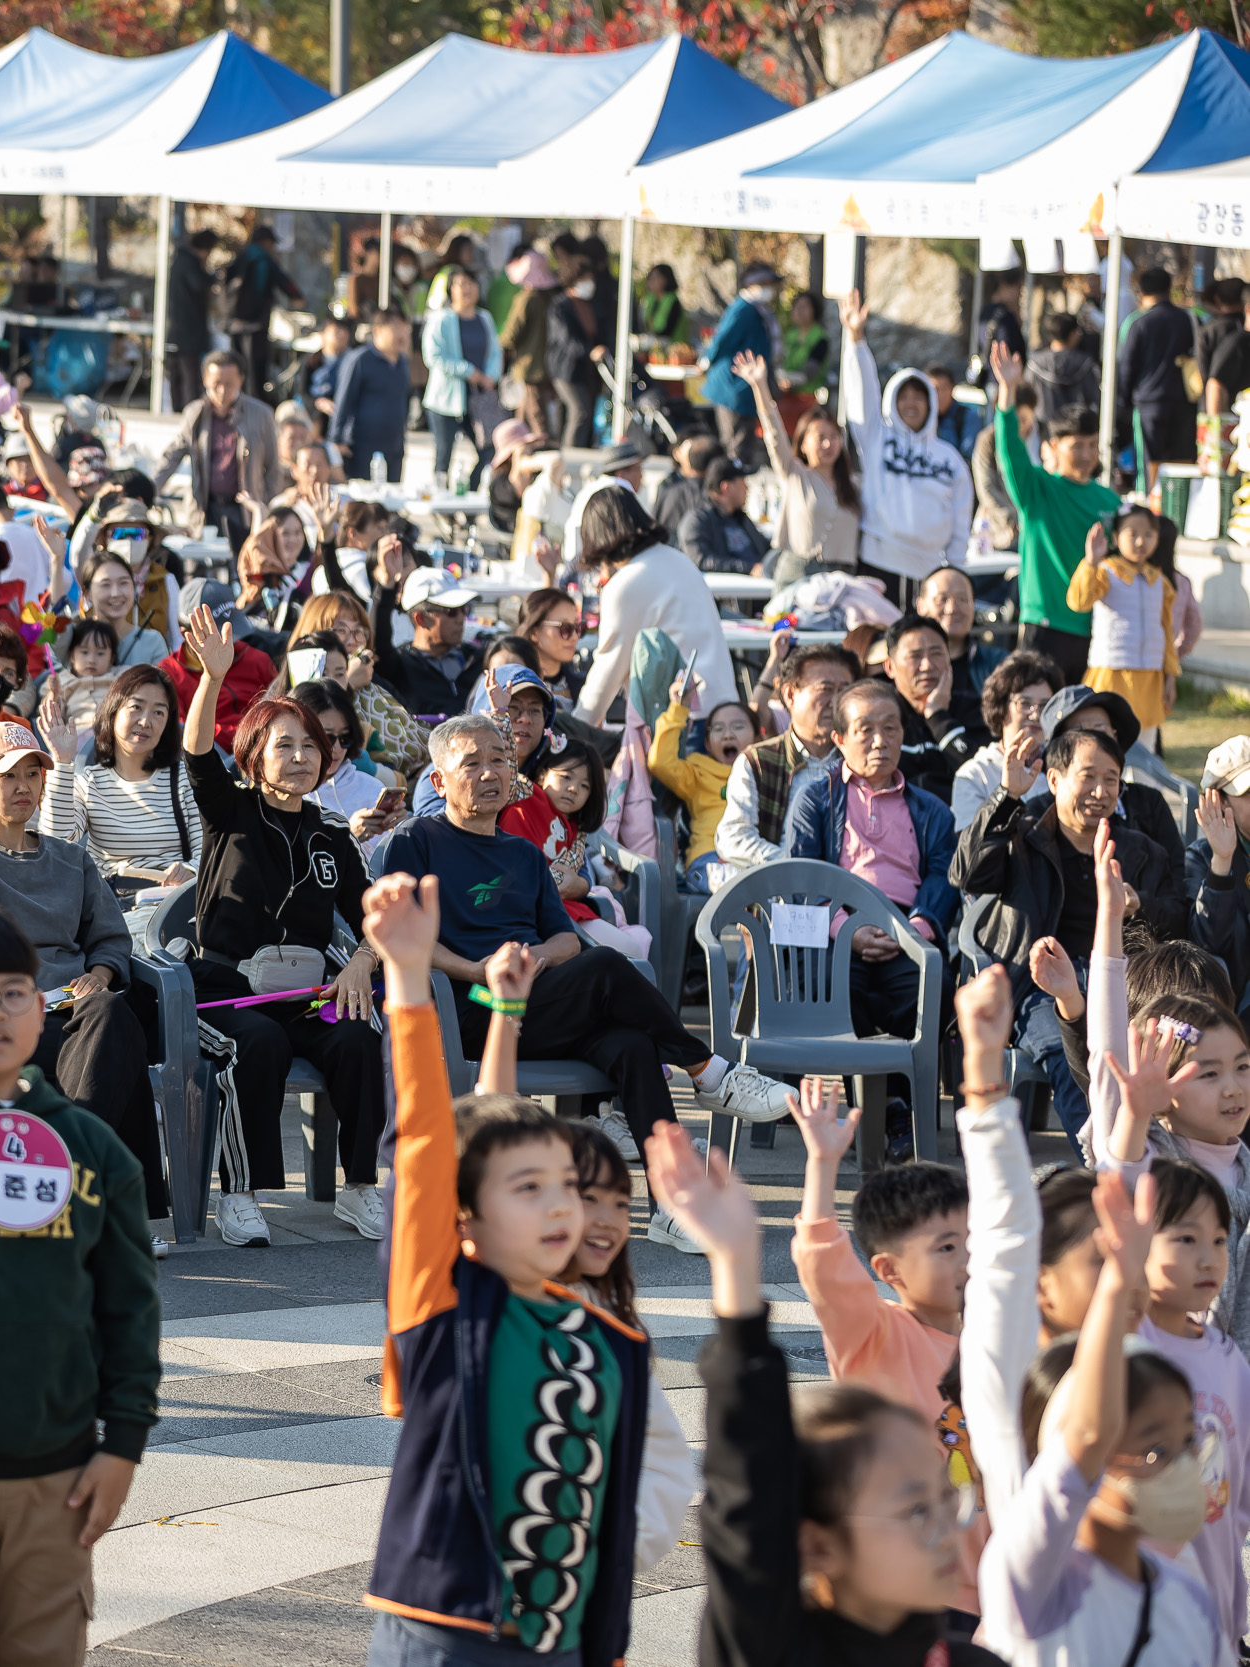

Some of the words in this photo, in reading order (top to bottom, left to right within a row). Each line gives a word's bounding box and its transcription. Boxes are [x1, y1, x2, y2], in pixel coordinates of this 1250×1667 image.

[1197, 202, 1245, 237] 광장동
[311, 851, 338, 888] G
[5, 1135, 24, 1160] 4
